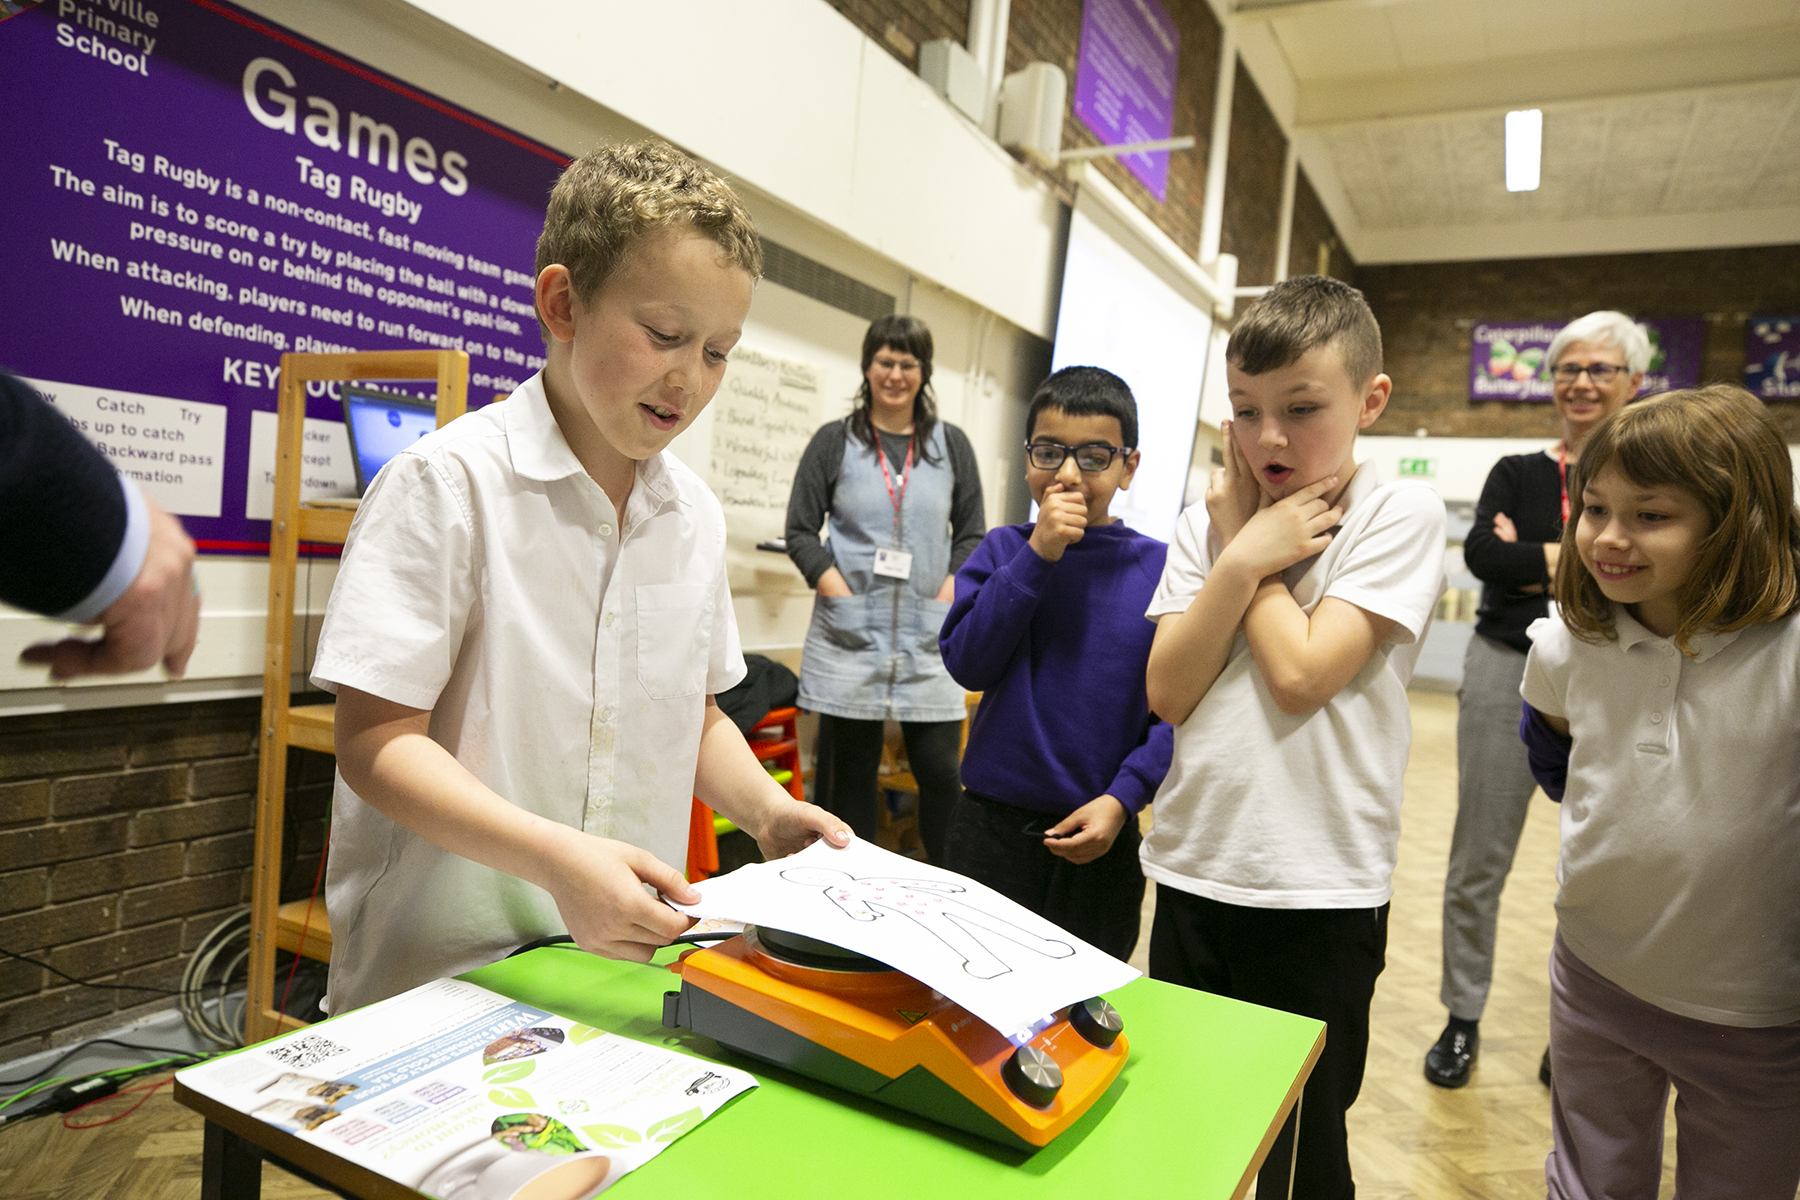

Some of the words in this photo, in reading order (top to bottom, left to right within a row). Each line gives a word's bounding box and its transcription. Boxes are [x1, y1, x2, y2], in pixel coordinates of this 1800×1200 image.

[58, 0, 156, 55] Primary
[94, 0, 159, 29] ville
[56, 22, 149, 77] School
[242, 56, 469, 196] Games
[103, 138, 146, 173] Tag
[153, 155, 221, 196] Rugby
[225, 178, 243, 200] is
[247, 189, 260, 206] a
[378, 226, 411, 252] fast
[412, 240, 465, 271] moving
[467, 254, 502, 280] team
[295, 155, 341, 199] Tag
[350, 175, 422, 225] Rugby
[50, 164, 97, 197] The
[102, 184, 144, 211] aim
[151, 194, 170, 218] is
[176, 202, 199, 226] to
[204, 214, 260, 244] score
[264, 231, 277, 248] a
[281, 232, 308, 259] try
[310, 241, 333, 265] by
[335, 251, 396, 284] placing
[398, 266, 425, 289] the
[427, 274, 456, 297] ball
[457, 284, 488, 306] with
[489, 293, 499, 309] a
[129, 221, 224, 260] pressure
[228, 247, 254, 268] on
[258, 255, 279, 274] or
[283, 258, 342, 291] behind
[346, 275, 374, 299] the
[376, 286, 460, 321] opponent's
[50, 236, 120, 274] When
[238, 285, 308, 317] players
[310, 300, 353, 327] need
[356, 311, 375, 332] to
[377, 320, 405, 339] run
[406, 324, 464, 352] forward
[465, 340, 484, 357] on
[486, 342, 502, 361] to
[503, 346, 526, 366] the
[120, 295, 183, 327] When
[223, 355, 281, 390] KEY
[94, 421, 115, 435] up
[121, 423, 138, 437] to
[142, 426, 186, 442] catch
[96, 396, 146, 416] Catch
[180, 408, 203, 425] Try
[96, 440, 174, 464] Backward
[179, 450, 214, 467] pass
[489, 1011, 542, 1035] Win
